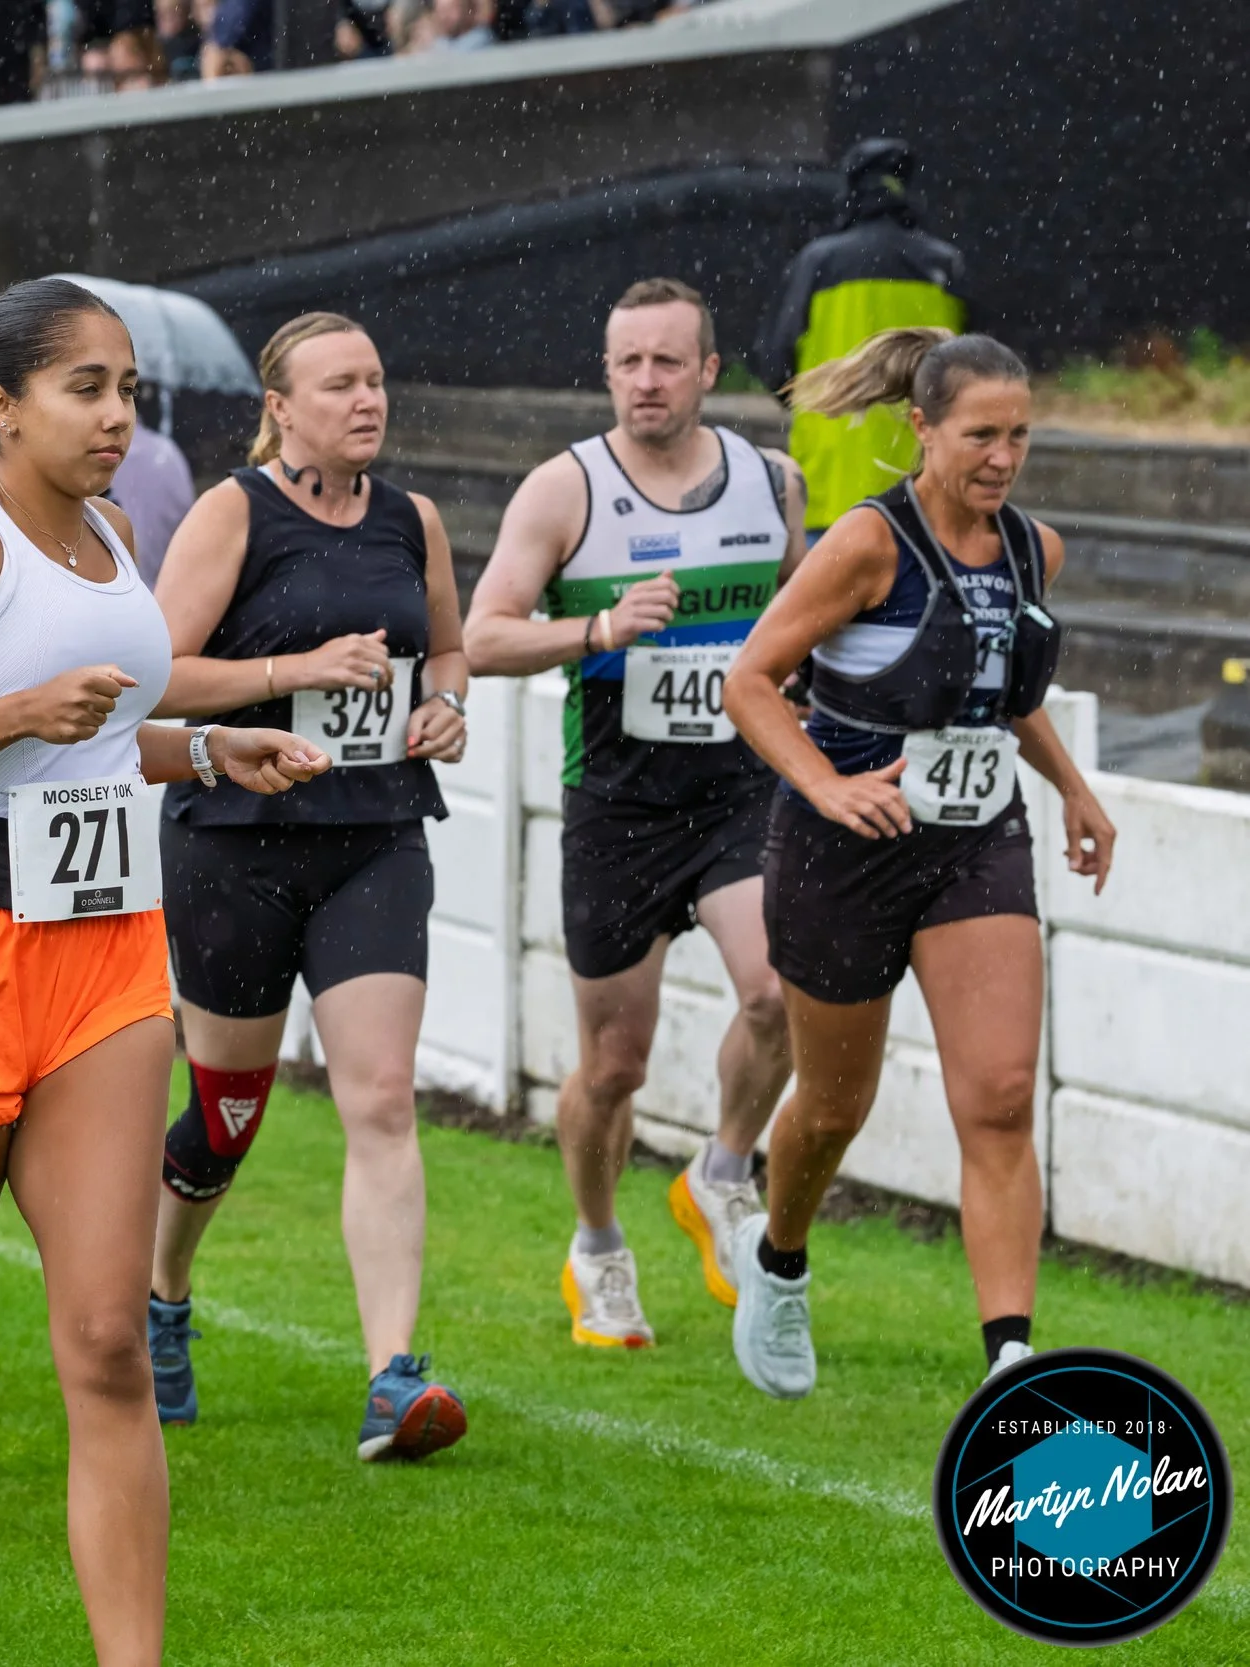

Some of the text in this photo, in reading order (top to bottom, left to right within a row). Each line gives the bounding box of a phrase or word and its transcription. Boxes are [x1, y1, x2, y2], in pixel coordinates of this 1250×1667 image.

[322, 686, 394, 738] 329
[651, 668, 726, 716] 440
[43, 783, 133, 804] MOSSLEY 10K
[926, 749, 999, 799] 413
[49, 807, 129, 884] 271
